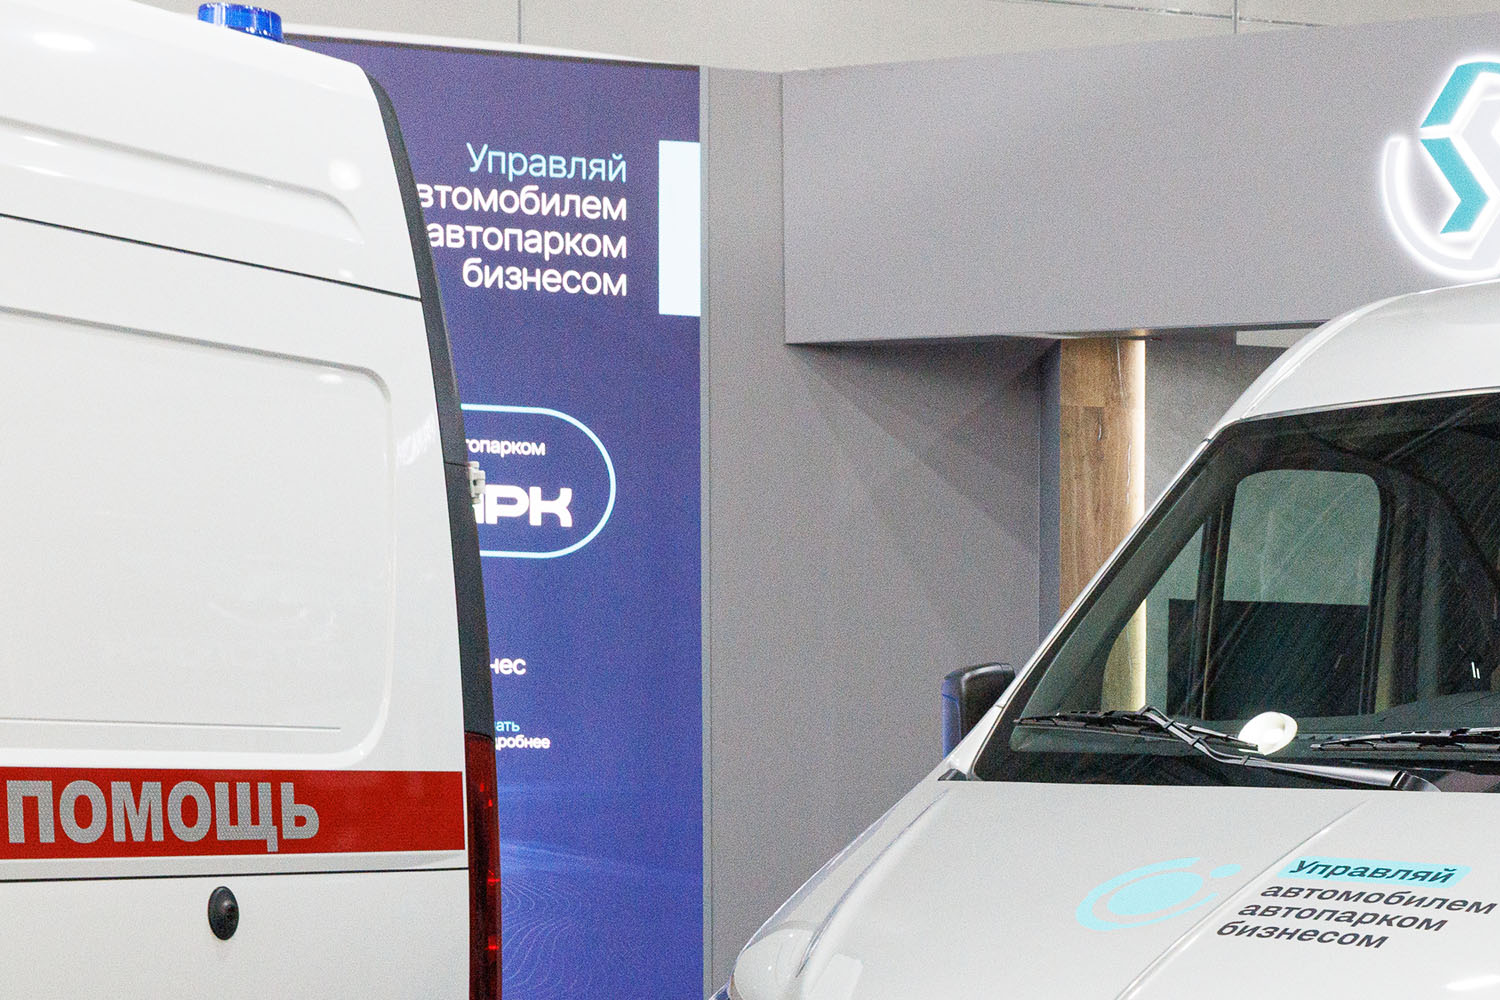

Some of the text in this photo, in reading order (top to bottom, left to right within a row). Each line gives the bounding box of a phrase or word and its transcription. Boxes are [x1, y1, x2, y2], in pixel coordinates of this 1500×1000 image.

[466, 142, 627, 183] Управляй
[416, 183, 627, 221] втомобилем
[427, 222, 627, 261] автопарком
[462, 257, 627, 296] бизнесом
[465, 438, 546, 458] опарком
[6, 780, 320, 852] ПОМОЩЬ
[1289, 859, 1458, 884] Управляй
[1260, 884, 1498, 915] автомобилем
[1237, 903, 1449, 933] автопарком
[1215, 921, 1389, 950] бизнесом
